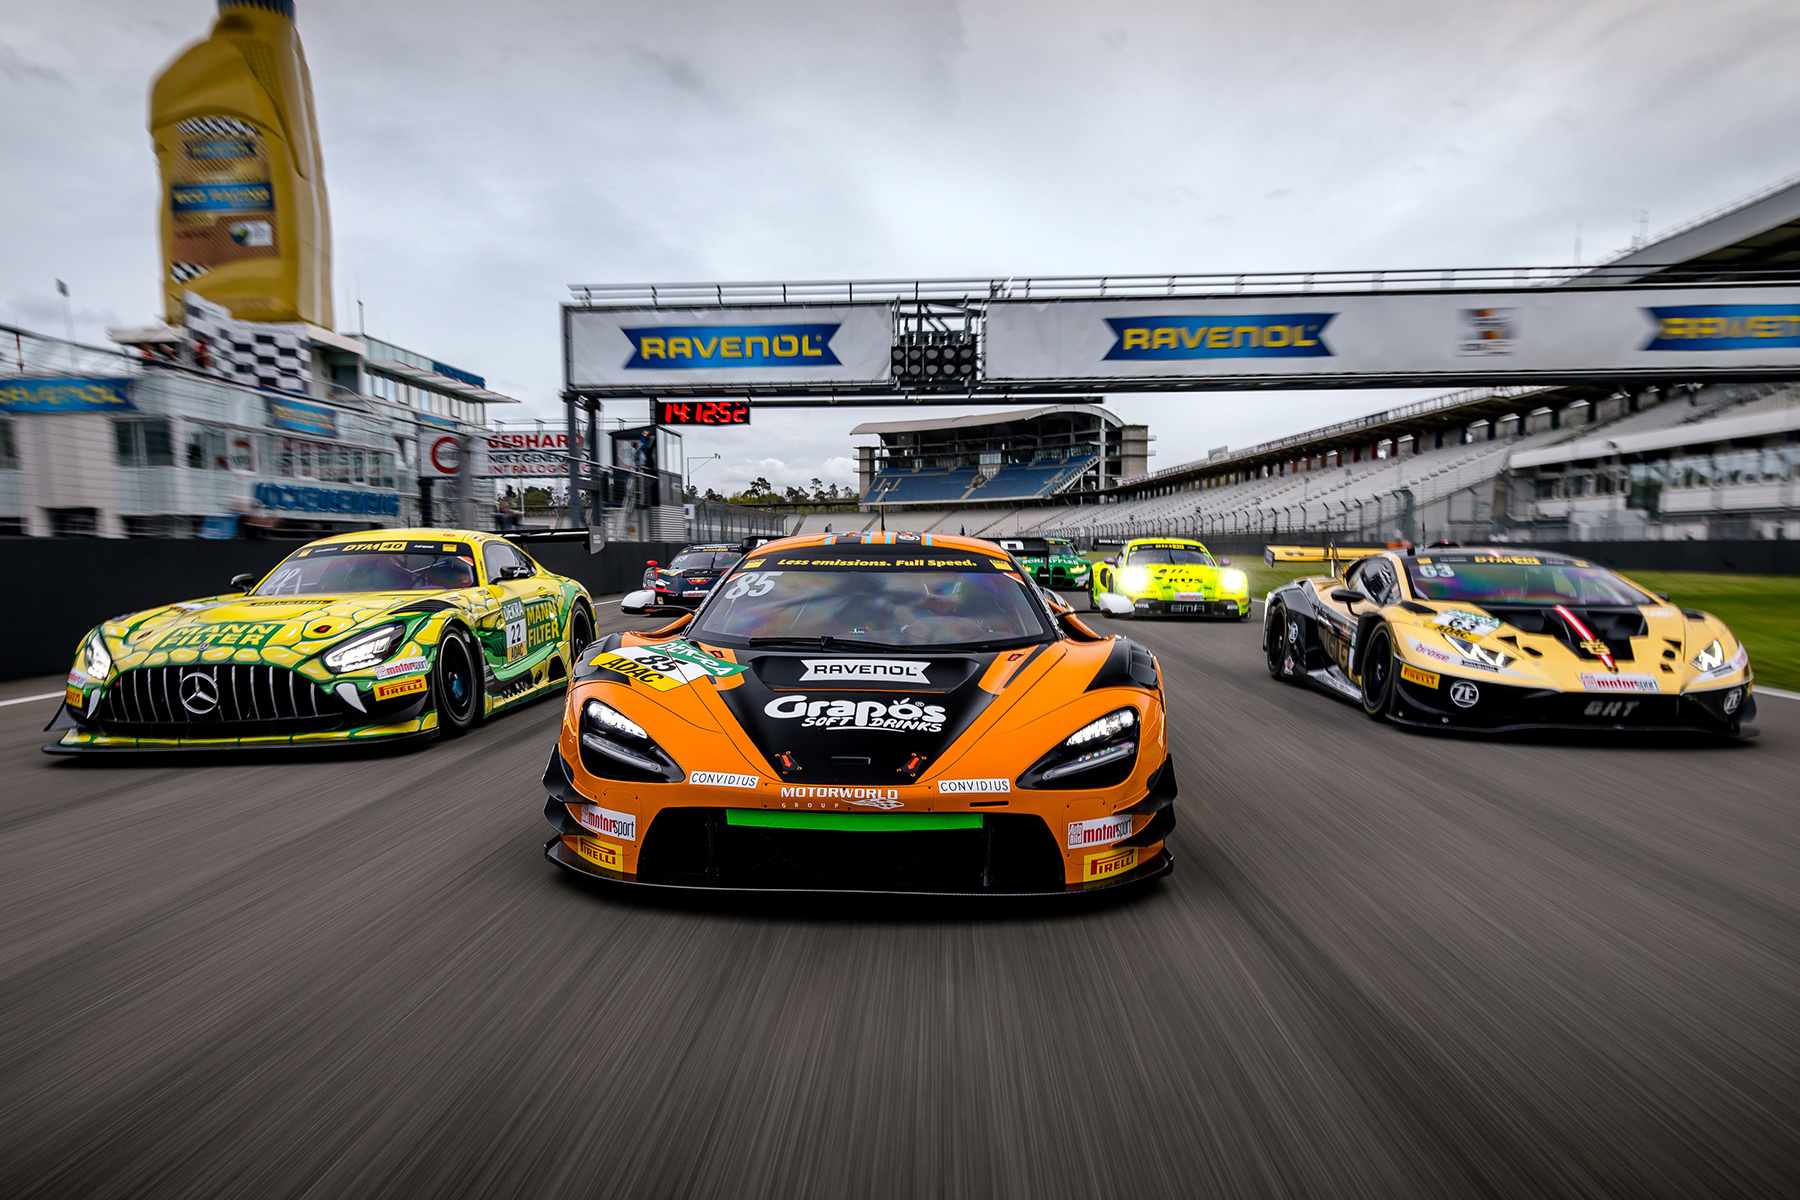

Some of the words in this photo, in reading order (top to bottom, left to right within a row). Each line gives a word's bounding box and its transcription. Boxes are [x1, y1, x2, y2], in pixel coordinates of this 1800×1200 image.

[640, 334, 822, 360] RAVENOL
[1123, 325, 1318, 350] RAVENOL
[342, 543, 381, 552] DTM
[383, 542, 403, 550] 40
[811, 559, 892, 567] emissions.
[927, 559, 978, 568] Speed.
[1419, 562, 1455, 577] 63
[724, 571, 784, 599] 85
[503, 600, 524, 621] DEKRA
[526, 601, 557, 626] MANN
[159, 632, 260, 648] FILTER
[172, 624, 277, 638] MANN
[510, 623, 521, 645] 22
[528, 621, 560, 648] FILTER
[650, 641, 734, 676] DEKRA
[1415, 643, 1450, 663] brose
[601, 658, 664, 682] ADAC
[634, 655, 689, 672] 85
[813, 664, 918, 676] RAVENOL
[1403, 667, 1436, 686] PIRELLI
[378, 679, 422, 697] PIRELLI
[801, 716, 854, 727] SOFT
[868, 717, 942, 733] DRINKS
[691, 772, 757, 788] CONVIDIUS
[940, 780, 1009, 792] CONVIDIUS
[780, 787, 898, 800] MOTORWORLD
[580, 838, 617, 865] PIRELLI
[1090, 848, 1135, 876] PIRELLI
